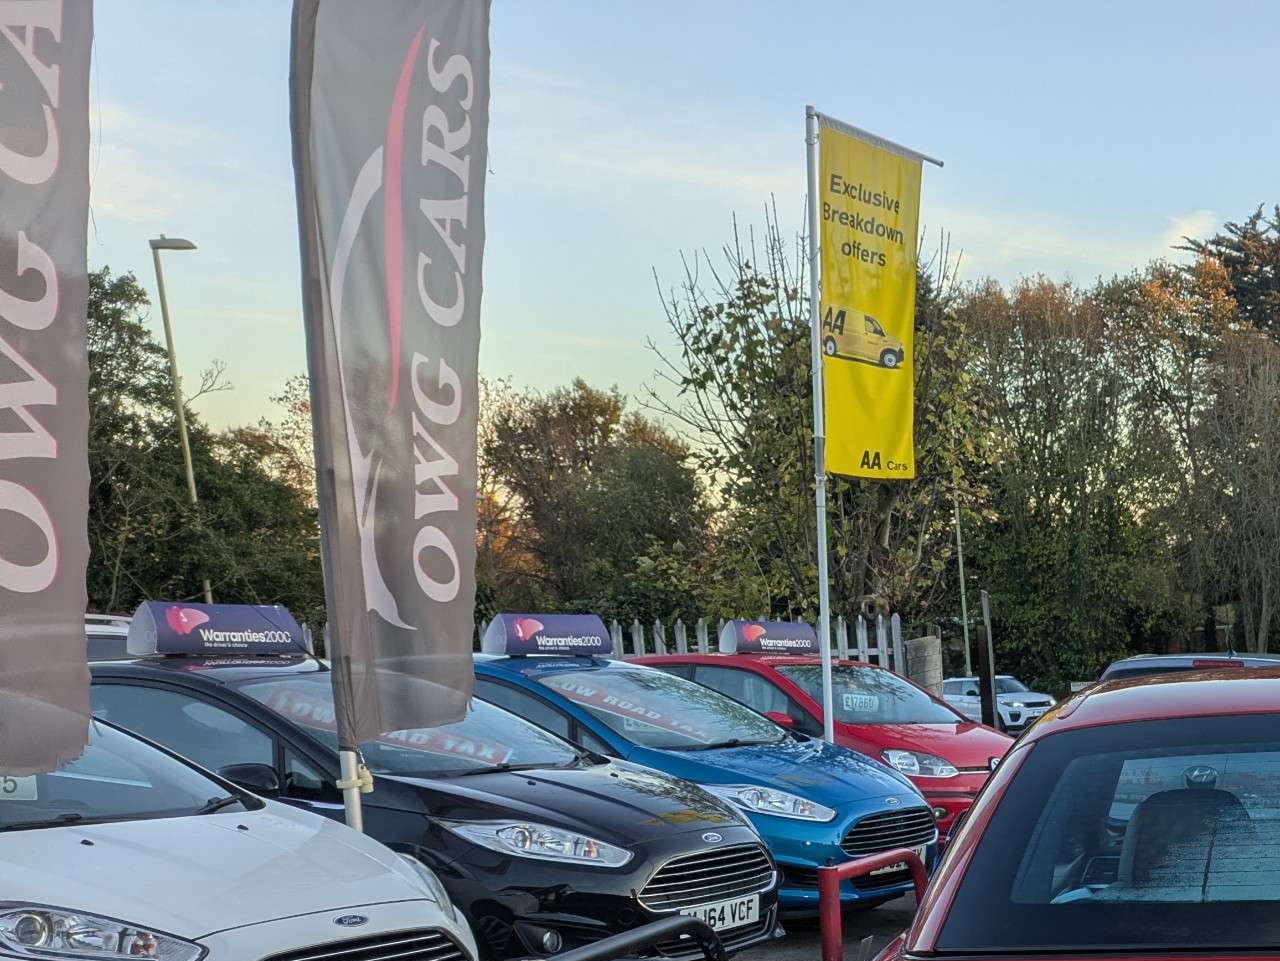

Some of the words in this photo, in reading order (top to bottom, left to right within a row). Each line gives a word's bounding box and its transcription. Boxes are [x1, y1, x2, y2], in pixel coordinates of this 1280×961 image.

[417, 38, 473, 327] CARS
[830, 173, 900, 214] Exclusive
[823, 201, 904, 245] Breakdown
[841, 240, 886, 267] offers
[823, 306, 846, 336] AA
[860, 450, 882, 470] AA
[886, 460, 908, 471] Cars
[411, 351, 462, 602] OWG
[199, 628, 292, 643] Warranties2000
[536, 635, 602, 647] Warranties2000
[603, 695, 662, 720] ROAD
[443, 739, 496, 759] TAX
[730, 899, 754, 923] VCF
